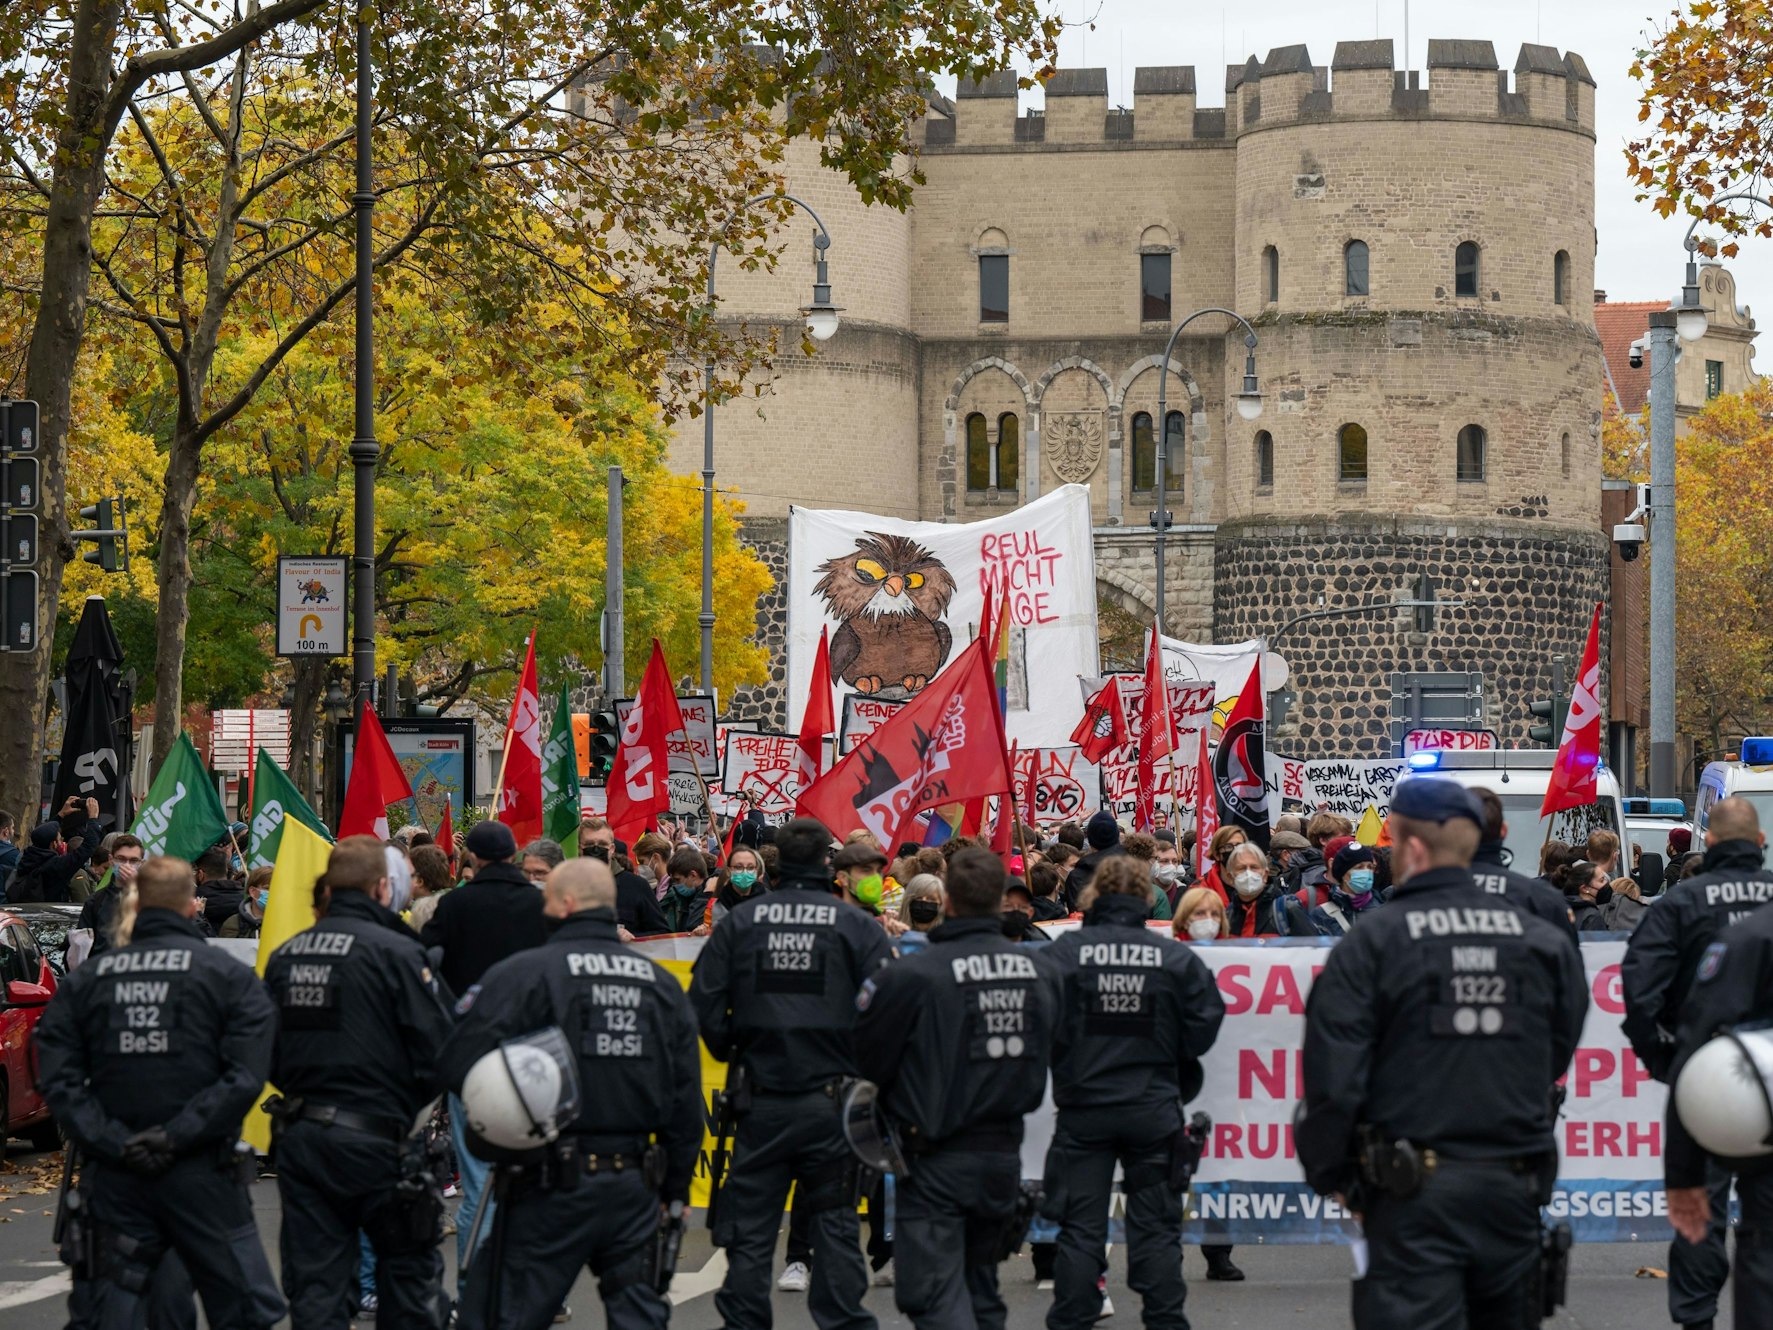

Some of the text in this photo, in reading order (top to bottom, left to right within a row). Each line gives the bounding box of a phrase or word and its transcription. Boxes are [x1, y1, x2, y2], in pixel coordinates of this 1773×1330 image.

[980, 530, 1055, 562] REUL
[296, 640, 328, 650] 100 m
[1408, 728, 1491, 750] FÜR DIE
[1218, 775, 1248, 815] AKTION
[753, 904, 836, 925] POLIZEI
[1406, 910, 1523, 939] POLIZEI
[768, 932, 815, 951] NRW
[97, 949, 192, 976] POLIZEI
[770, 952, 812, 970] 1323
[1079, 943, 1162, 967] POLIZEI
[1452, 946, 1498, 971] NRW
[289, 964, 331, 985] NRW
[566, 953, 656, 982] POLIZEI
[951, 953, 1038, 983] POLIZEI
[115, 981, 169, 1004] NRW
[1098, 974, 1145, 993] NRW
[1450, 976, 1506, 1003] 1322
[592, 985, 642, 1008] NRW
[978, 989, 1026, 1010] NRW
[1100, 995, 1141, 1012] 1323
[125, 1006, 160, 1028] 132
[604, 1010, 637, 1031] 132
[984, 1012, 1024, 1033] 1321
[119, 1031, 168, 1053] BeSi
[596, 1034, 642, 1057] BeSi
